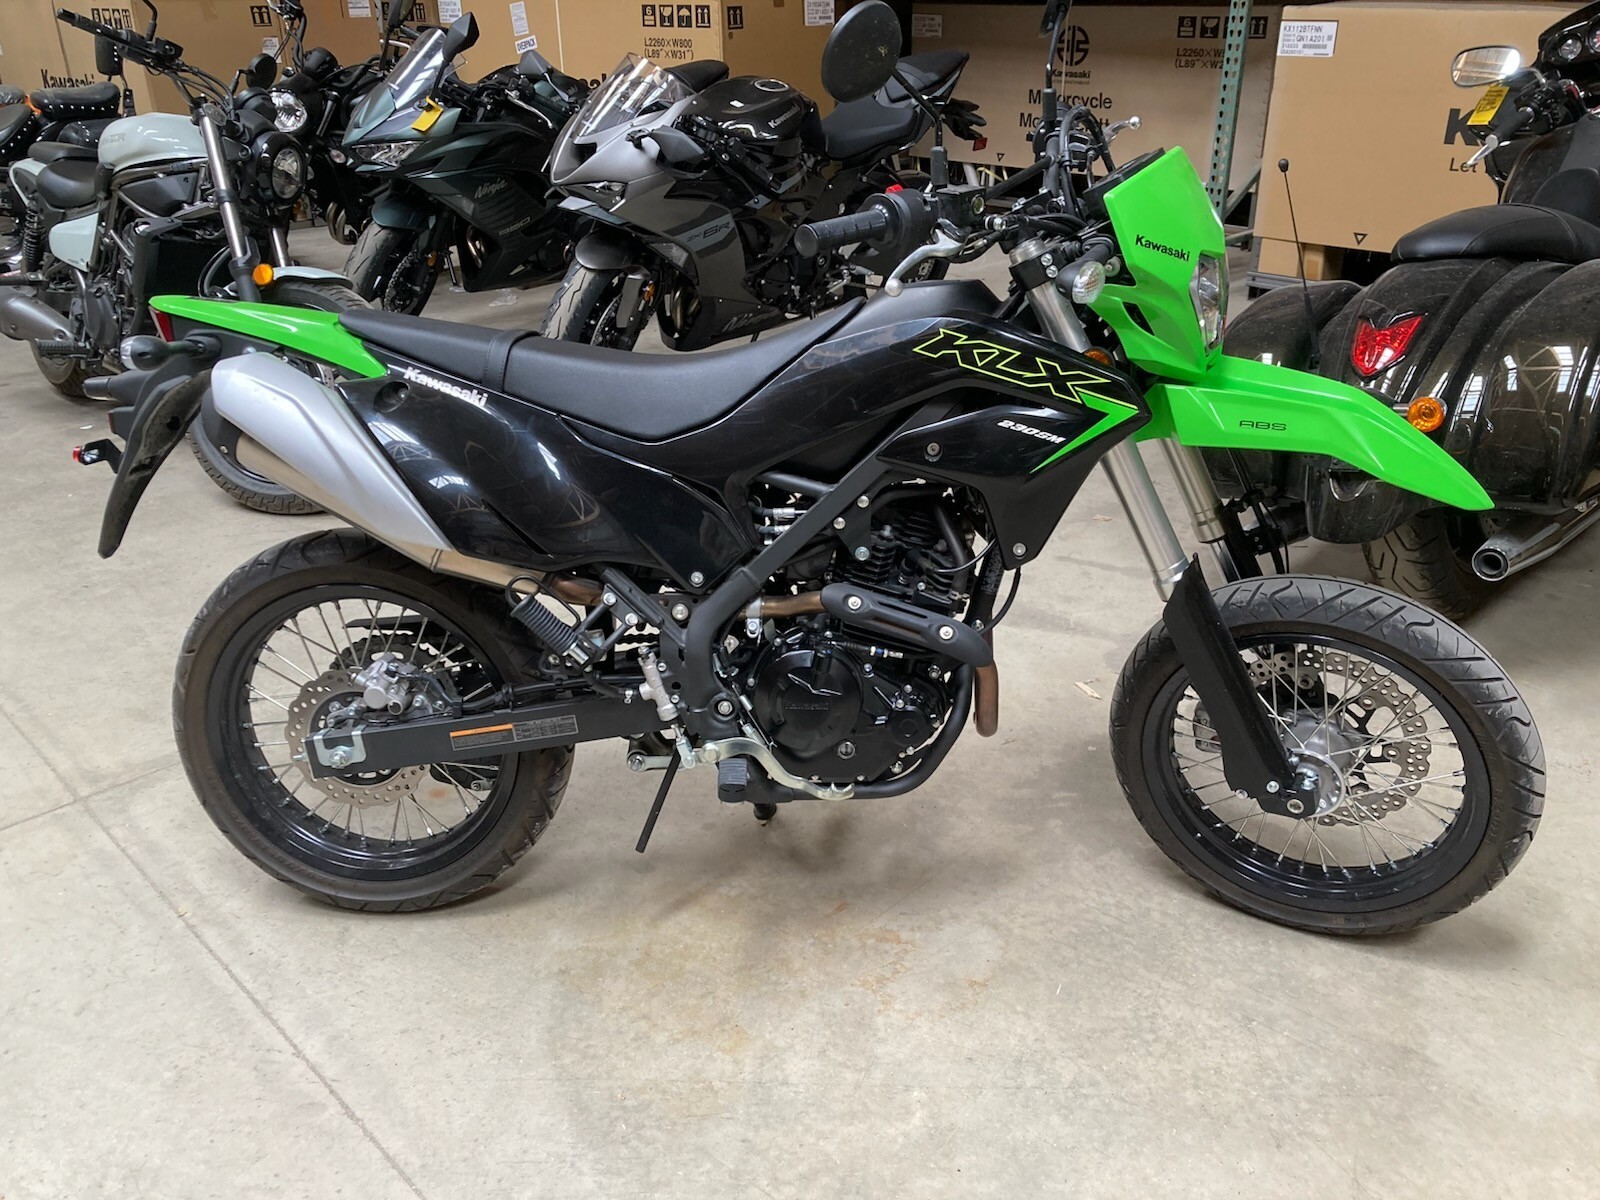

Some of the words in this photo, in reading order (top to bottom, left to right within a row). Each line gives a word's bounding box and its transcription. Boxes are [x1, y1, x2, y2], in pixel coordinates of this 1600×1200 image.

[474, 178, 508, 199] Ninja
[1135, 234, 1190, 261] Kawasaki
[912, 328, 1112, 404] KLX
[403, 366, 489, 408] Kawasaki
[996, 419, 1067, 444] 230SM
[1239, 419, 1287, 431] ABS
